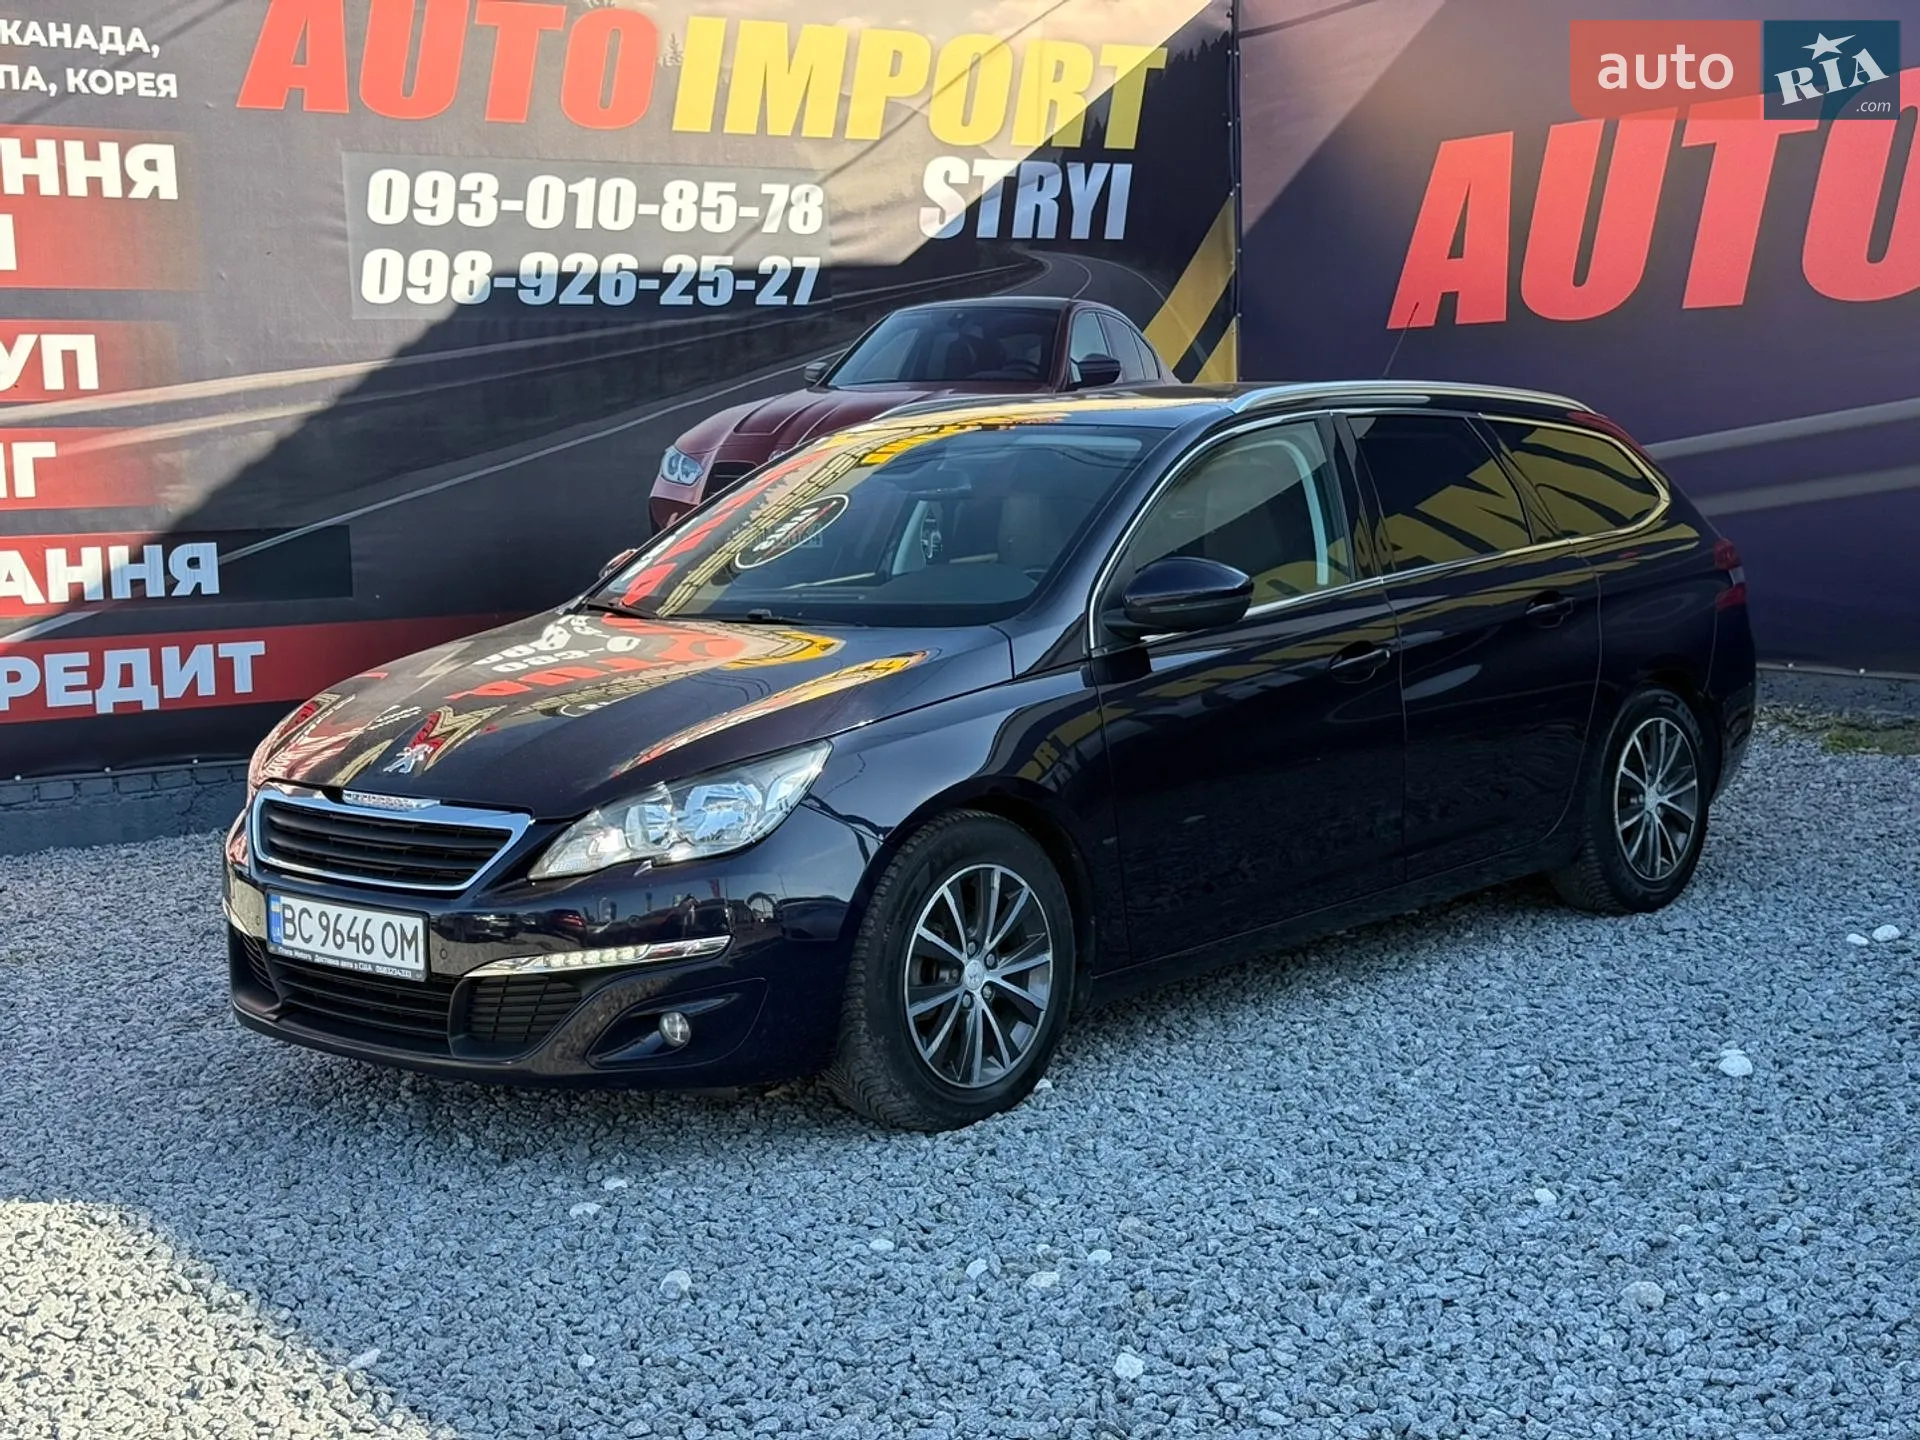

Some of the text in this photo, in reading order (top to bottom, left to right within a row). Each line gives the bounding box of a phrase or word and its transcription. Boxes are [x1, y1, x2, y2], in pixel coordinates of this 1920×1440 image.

[0, 19, 160, 57] КАНАДА,
[66, 67, 178, 98] КОРЕЯ
[236, 0, 1168, 150] AUTO IMPORT
[366, 167, 825, 235] 093-010-85-78
[919, 155, 1132, 241] STRYI
[1386, 66, 1920, 330] AUTO
[360, 248, 821, 306] 098-926-25-27
[0, 541, 220, 604] АННЯ
[282, 903, 420, 963] BC 9646 OM
